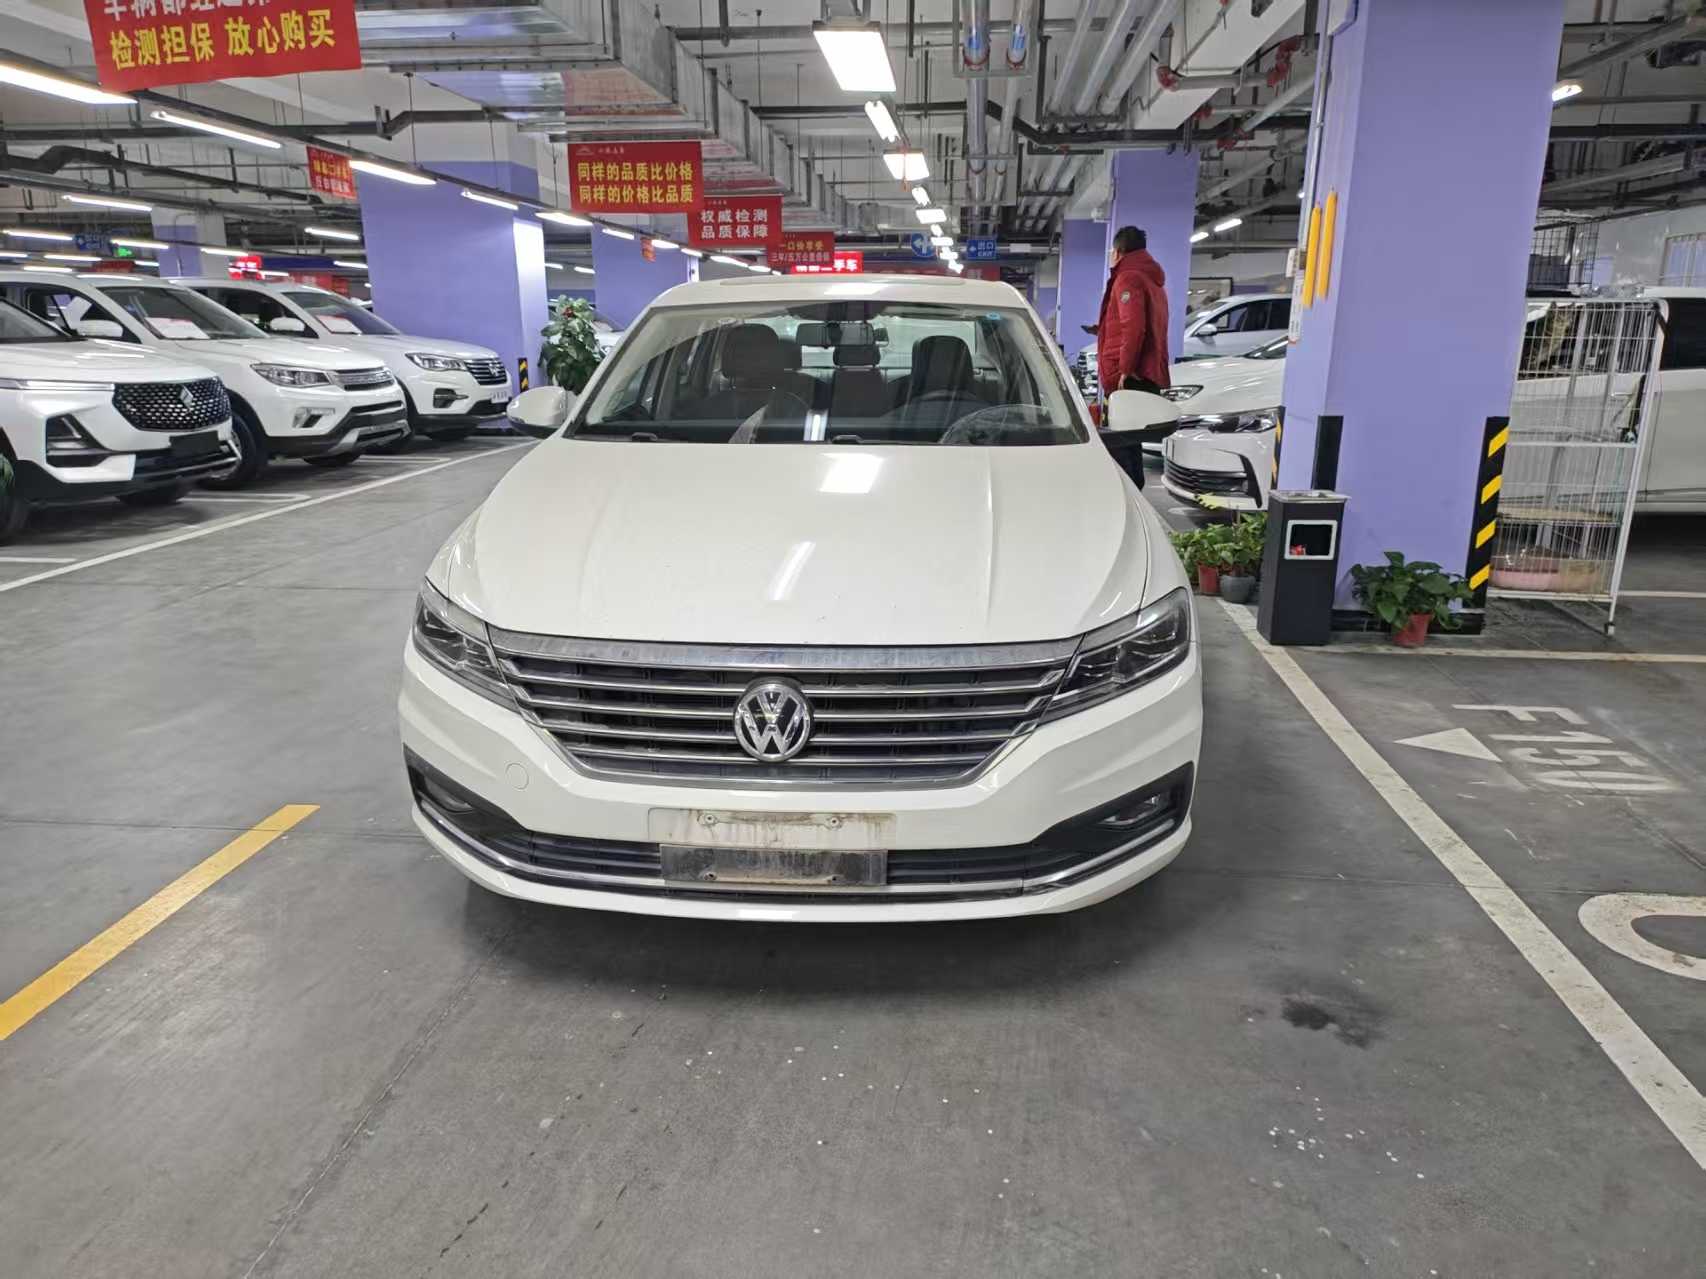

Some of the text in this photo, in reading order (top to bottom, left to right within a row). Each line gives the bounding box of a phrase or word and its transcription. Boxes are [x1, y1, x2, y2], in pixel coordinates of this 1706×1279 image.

[110, 22, 215, 71] 检测担保
[224, 8, 336, 57] 放心购买
[577, 161, 693, 181] 同样的品质比价格
[579, 184, 694, 204] 同样的价格比品质
[701, 208, 768, 223] 权威检测
[701, 224, 769, 240] 品质保障
